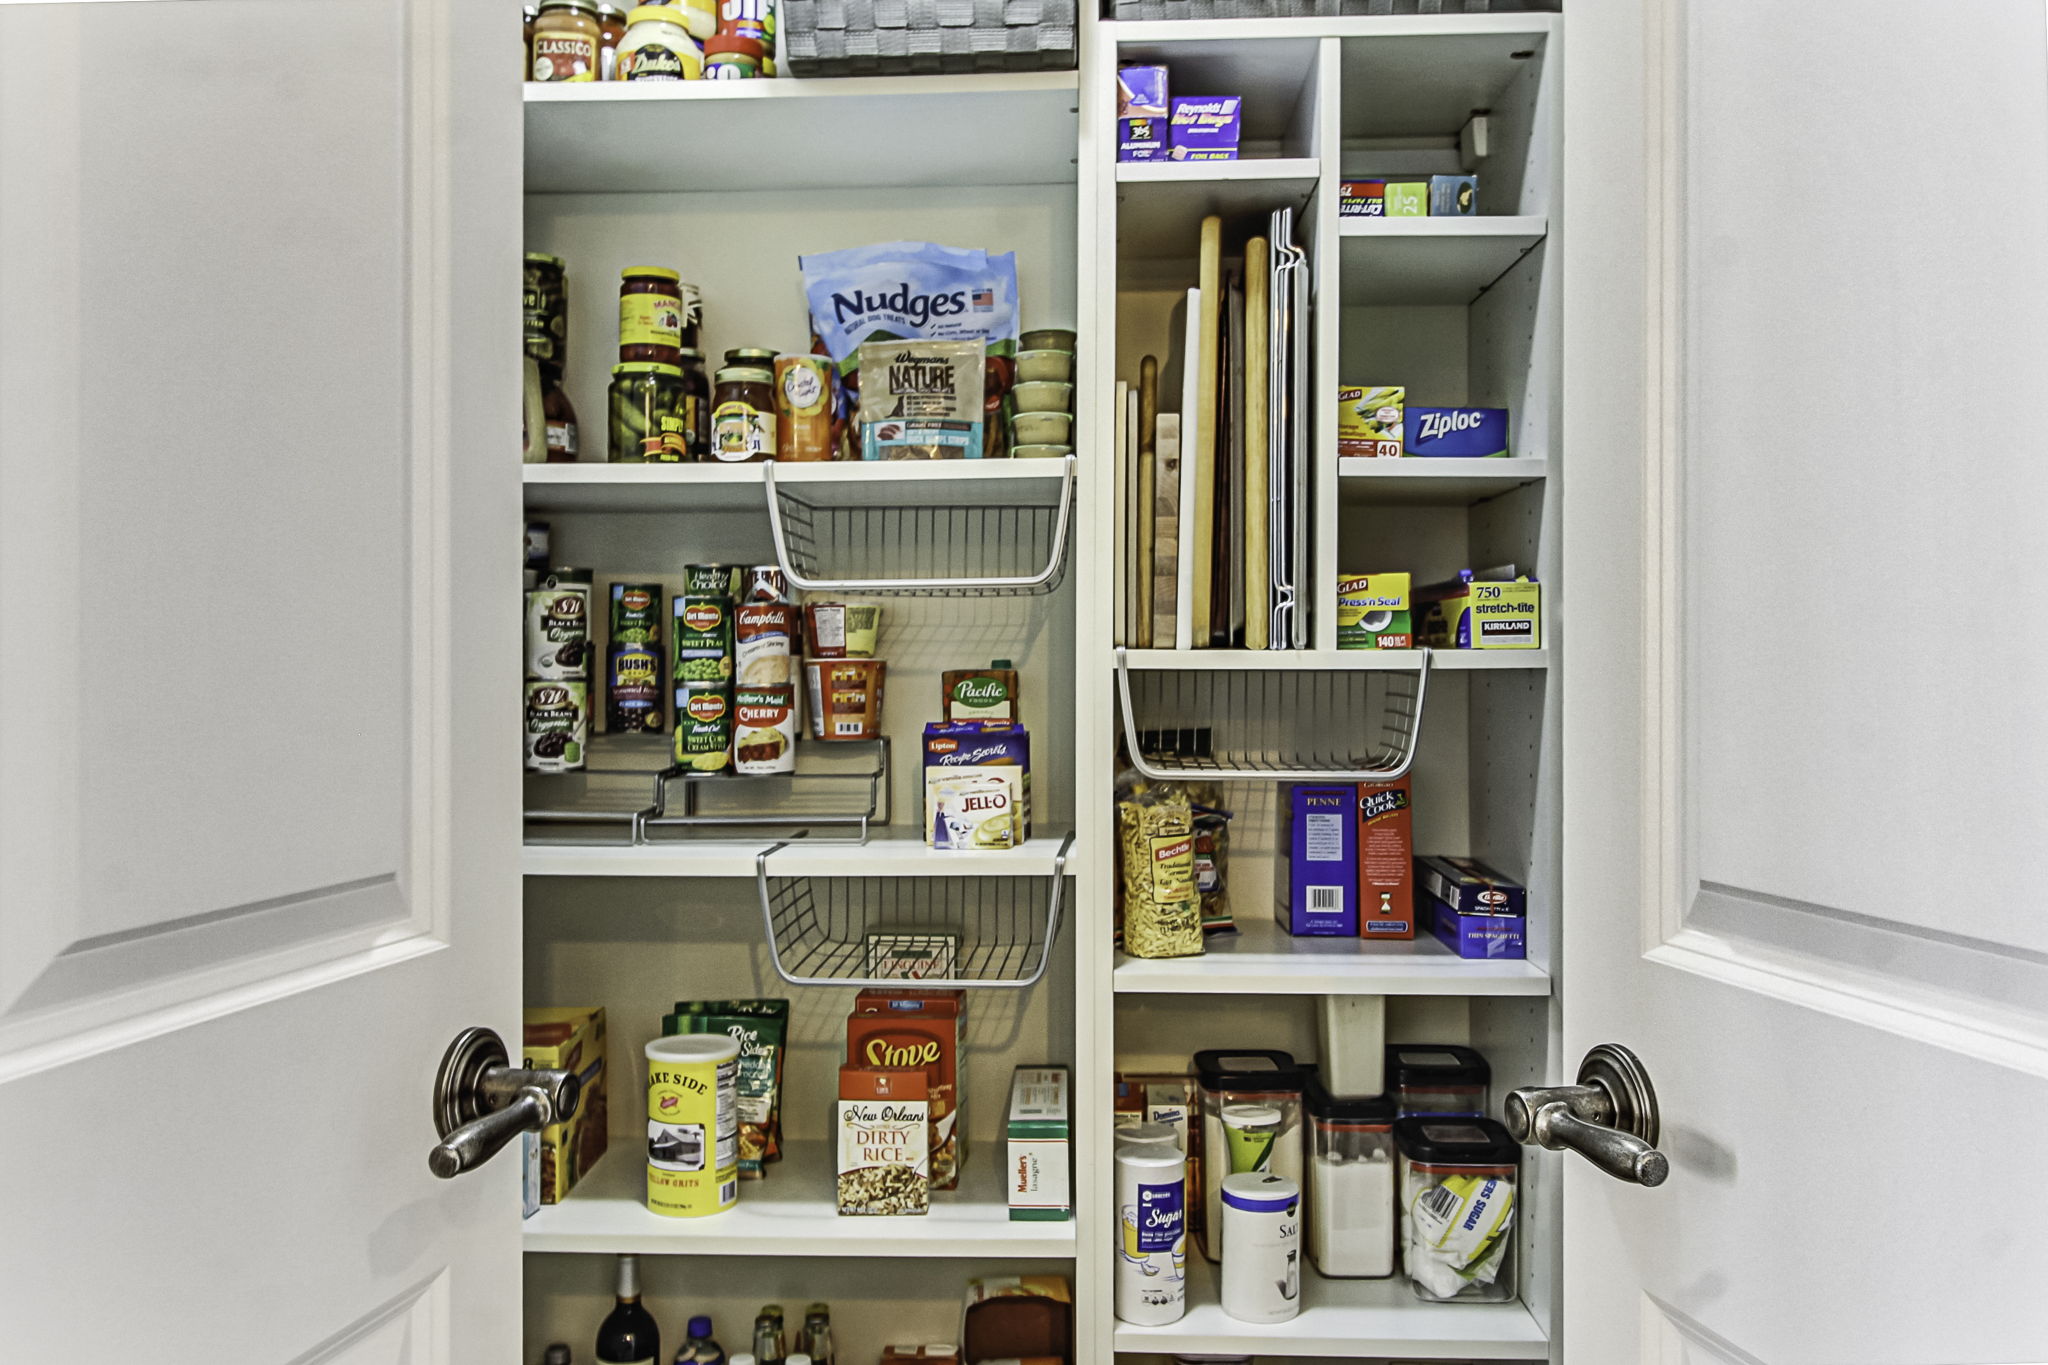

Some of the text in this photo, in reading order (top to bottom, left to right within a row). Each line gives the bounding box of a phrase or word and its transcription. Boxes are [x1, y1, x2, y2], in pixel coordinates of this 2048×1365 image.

[537, 40, 592, 56] CLASSICO
[632, 53, 681, 74] Duke's
[1177, 103, 1221, 116] Reynolds
[1402, 195, 1419, 214] 25
[831, 282, 966, 328] Nudges
[867, 314, 882, 322] DOG
[883, 313, 906, 325] TREATS
[894, 350, 950, 367] Wegmans
[889, 364, 956, 396] NATURE
[1419, 411, 1482, 439] Ziploc
[1379, 444, 1398, 457] 40
[694, 567, 729, 581] Healthy
[690, 578, 727, 590] Choice
[1337, 579, 1367, 594] GLAD
[1476, 586, 1501, 599] 750
[1377, 596, 1401, 606] Seal
[1475, 602, 1535, 614] stretch-tite
[686, 611, 719, 621] Del Monte
[1484, 622, 1530, 631] KIRKLAND
[682, 638, 723, 648] SWEET PEAS
[1377, 636, 1394, 648] 140
[957, 680, 1003, 699] Pacific
[550, 710, 573, 718] BEANS
[691, 702, 723, 711] Del Monte
[739, 707, 779, 722] CHERRY
[931, 741, 956, 750] Lipton
[939, 743, 1007, 766] Recipe Secrets
[961, 793, 1007, 813] JELL-O
[1307, 797, 1341, 806] PENNE
[1360, 791, 1395, 809] Quick
[727, 1024, 758, 1042] Rice
[866, 1038, 941, 1067] Stove
[673, 1073, 708, 1095] SIDE
[843, 1104, 925, 1122] New Orleans
[1153, 1110, 1180, 1122] Domino
[857, 1130, 910, 1145] DIRTY
[863, 1147, 904, 1161] RICE
[1018, 1155, 1028, 1193] Mueller's
[1145, 1207, 1183, 1229] Sugar
[1463, 1199, 1487, 1231] SUGAR
